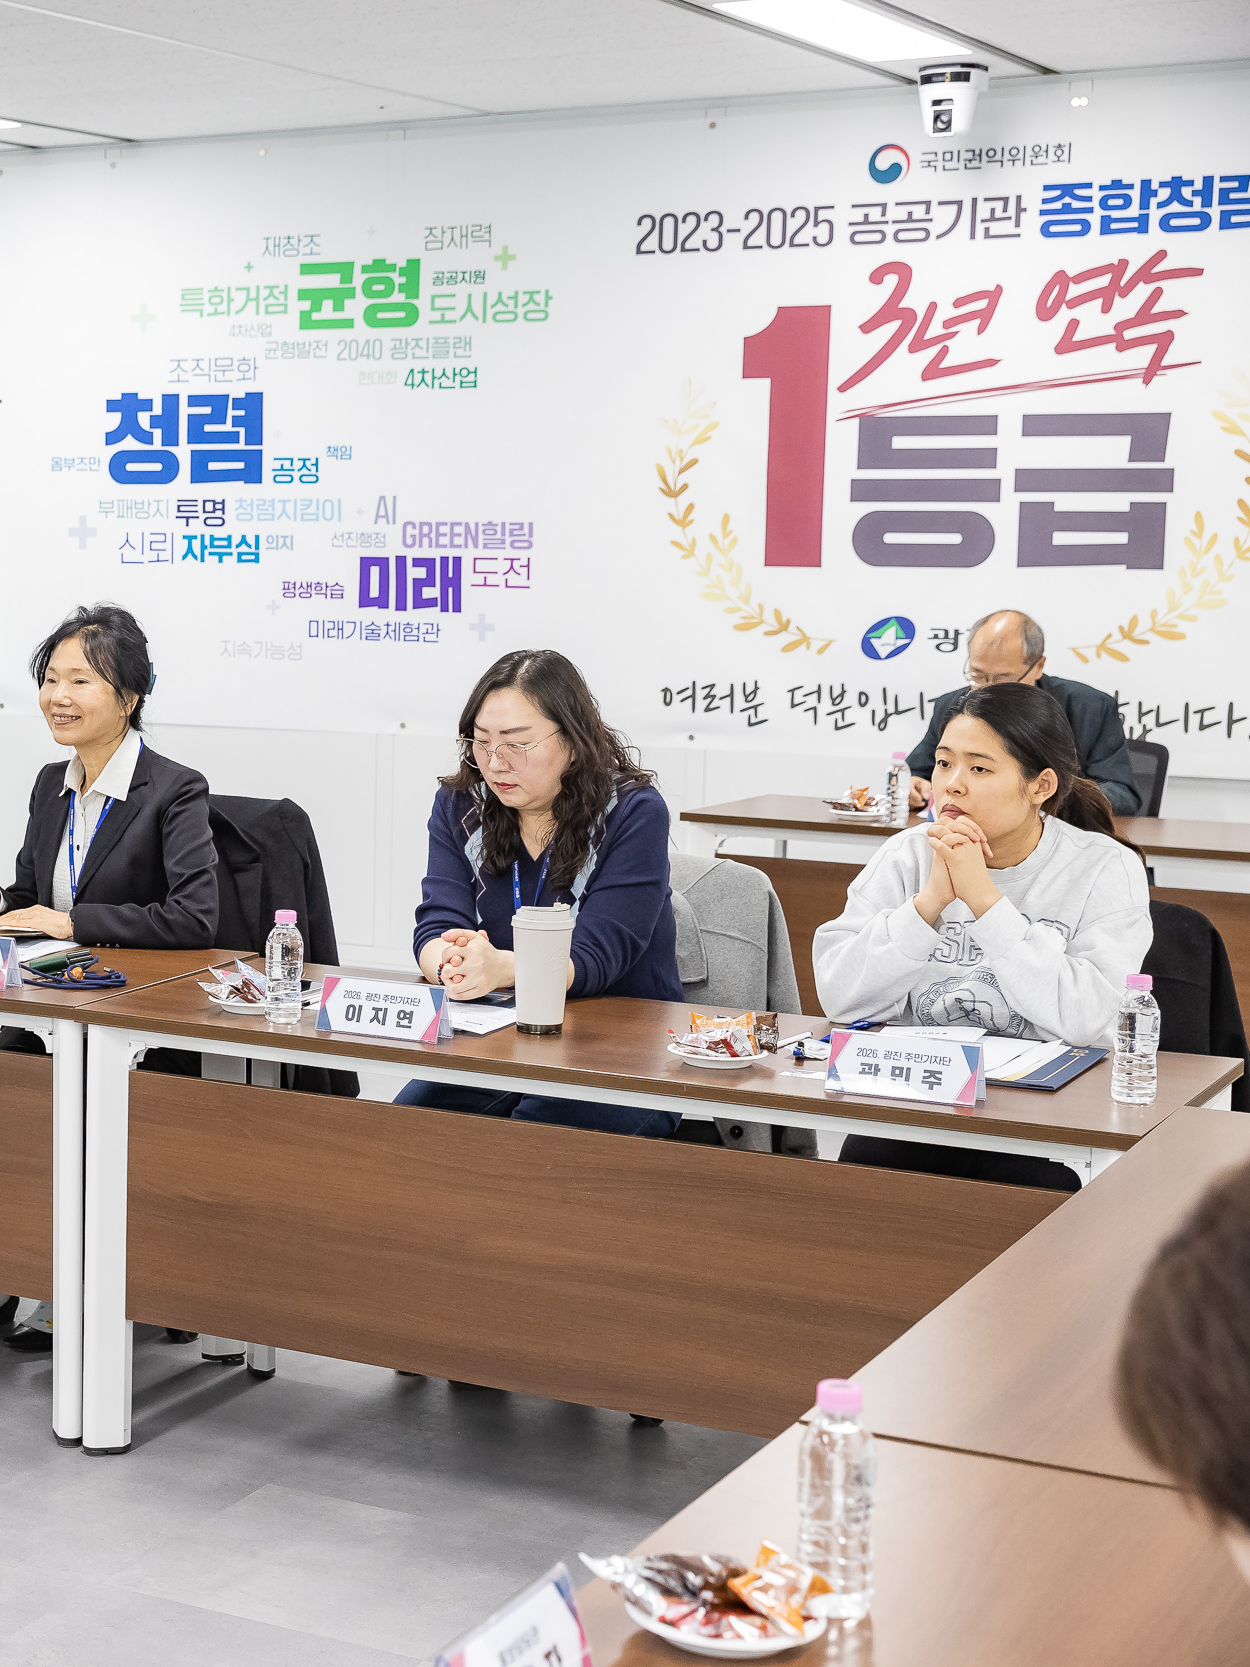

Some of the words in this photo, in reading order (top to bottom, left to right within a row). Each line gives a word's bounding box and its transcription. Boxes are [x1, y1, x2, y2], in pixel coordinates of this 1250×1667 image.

[921, 143, 1071, 172] 국민권익위원회
[424, 224, 491, 251] 잠재력
[636, 206, 834, 255] 2023-2025
[848, 195, 1027, 245] 공공기관
[263, 234, 321, 257] 재창조
[433, 270, 485, 286] 공공지원
[180, 284, 288, 317] 특화거점
[297, 258, 421, 330] 균형
[429, 289, 553, 324] 도시성장
[229, 323, 272, 338] 4차산업
[837, 261, 1003, 394] 3년
[1036, 249, 1205, 387] 연속
[264, 340, 328, 360] 균형발전
[337, 338, 382, 361] 2040
[390, 336, 472, 360] 광진플랜
[168, 356, 259, 383] 조직문화
[404, 367, 477, 389] 4차산업
[105, 392, 263, 484] 청렴
[51, 457, 101, 472] 옴부즈만
[326, 446, 352, 460] 책임
[272, 458, 319, 483] 공정
[98, 499, 169, 519] 부패방지
[176, 499, 225, 527] 투명
[235, 498, 341, 522] 청렴지킴이
[374, 496, 396, 525] AI
[119, 532, 173, 564] 신뢰
[266, 535, 293, 550] 의지
[331, 532, 386, 548] 선진행정
[402, 521, 533, 550] GREEN힐링
[182, 534, 259, 563] 자부심
[359, 555, 462, 613] 미래
[471, 558, 530, 588] 도전
[282, 581, 344, 599] 평생학습
[309, 620, 440, 643] 미래기술체험관
[928, 628, 971, 652] 광
[220, 640, 302, 661] 지속가능성
[661, 680, 768, 727] 여러분
[787, 682, 940, 731] 덕분입니
[365, 992, 380, 1002] 광진
[382, 994, 421, 1006] 주민기자단
[883, 1050, 902, 1061] 광진
[904, 1052, 951, 1066] 주민기자단
